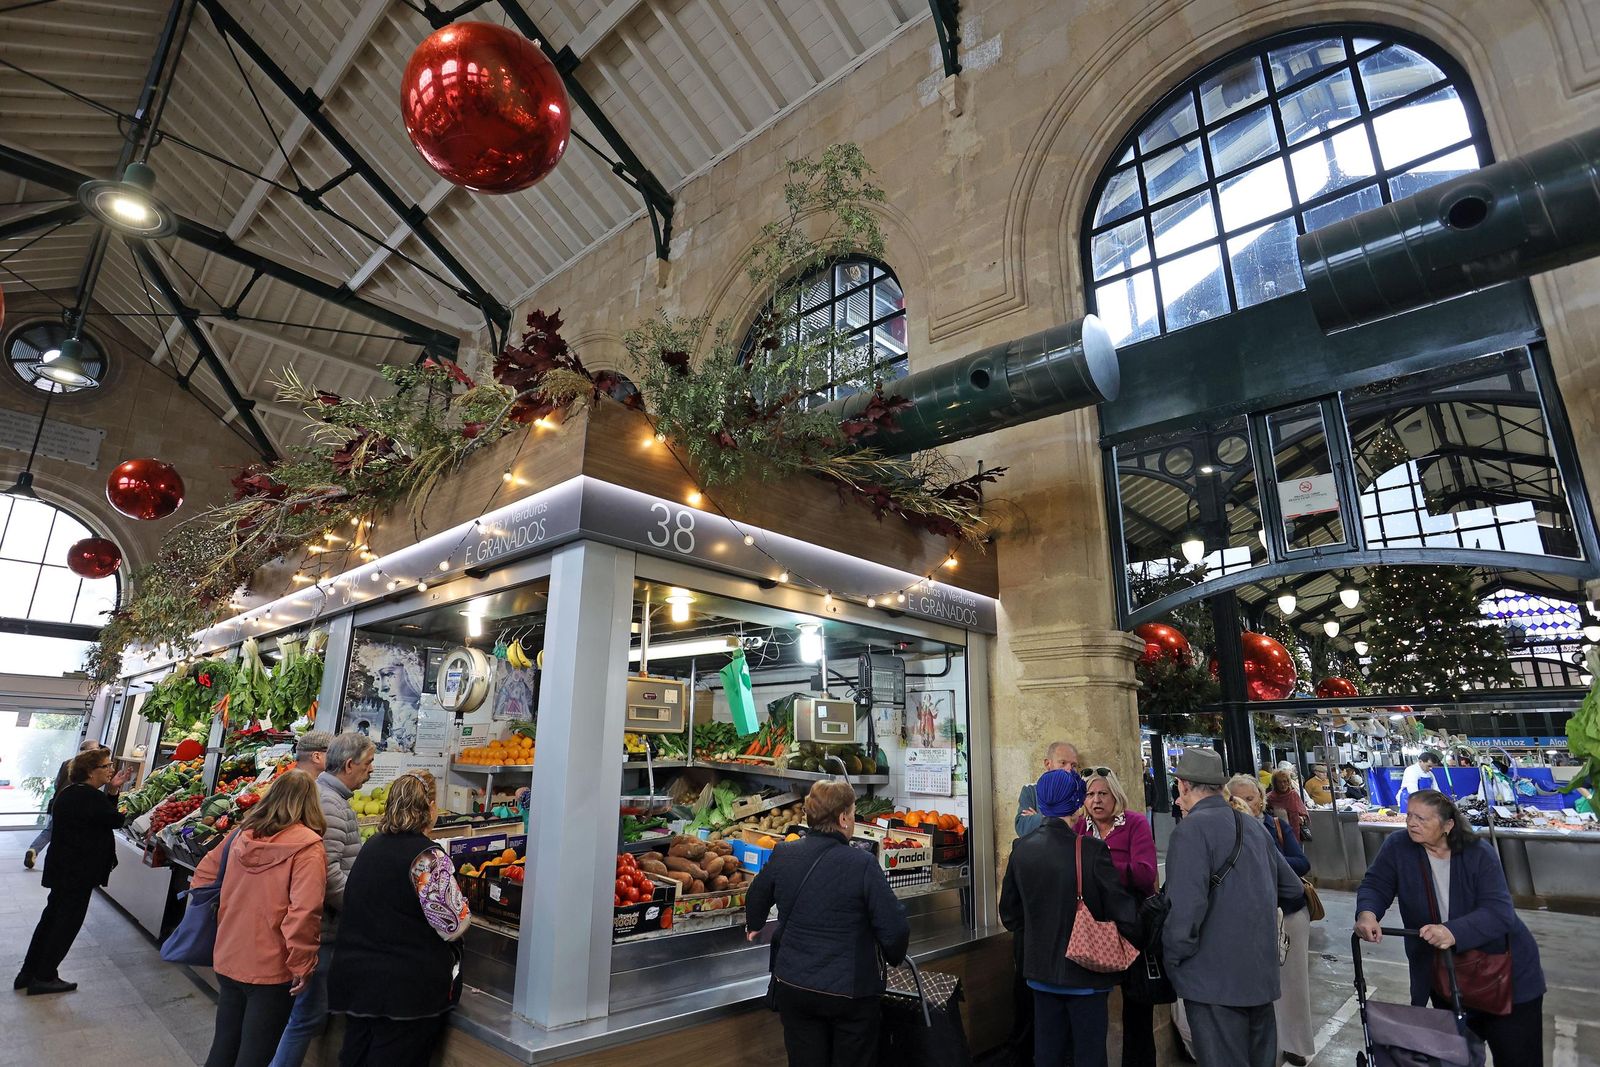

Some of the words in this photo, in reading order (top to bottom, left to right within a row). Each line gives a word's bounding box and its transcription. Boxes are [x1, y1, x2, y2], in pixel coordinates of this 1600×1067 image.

[480, 519, 503, 536] utas
[504, 516, 510, 529] y
[511, 502, 548, 523] Verduras
[647, 502, 695, 554] 38
[465, 546, 474, 566] E.
[477, 518, 547, 561] GRANADOS
[908, 593, 918, 611] E.
[920, 597, 978, 626] GRANADOS
[920, 585, 941, 598] Frutas
[942, 591, 947, 602] y
[947, 590, 976, 607] Verduras
[1492, 738, 1526, 747] Muñoz
[1549, 739, 1568, 747] Alon
[898, 851, 926, 864] nadal
